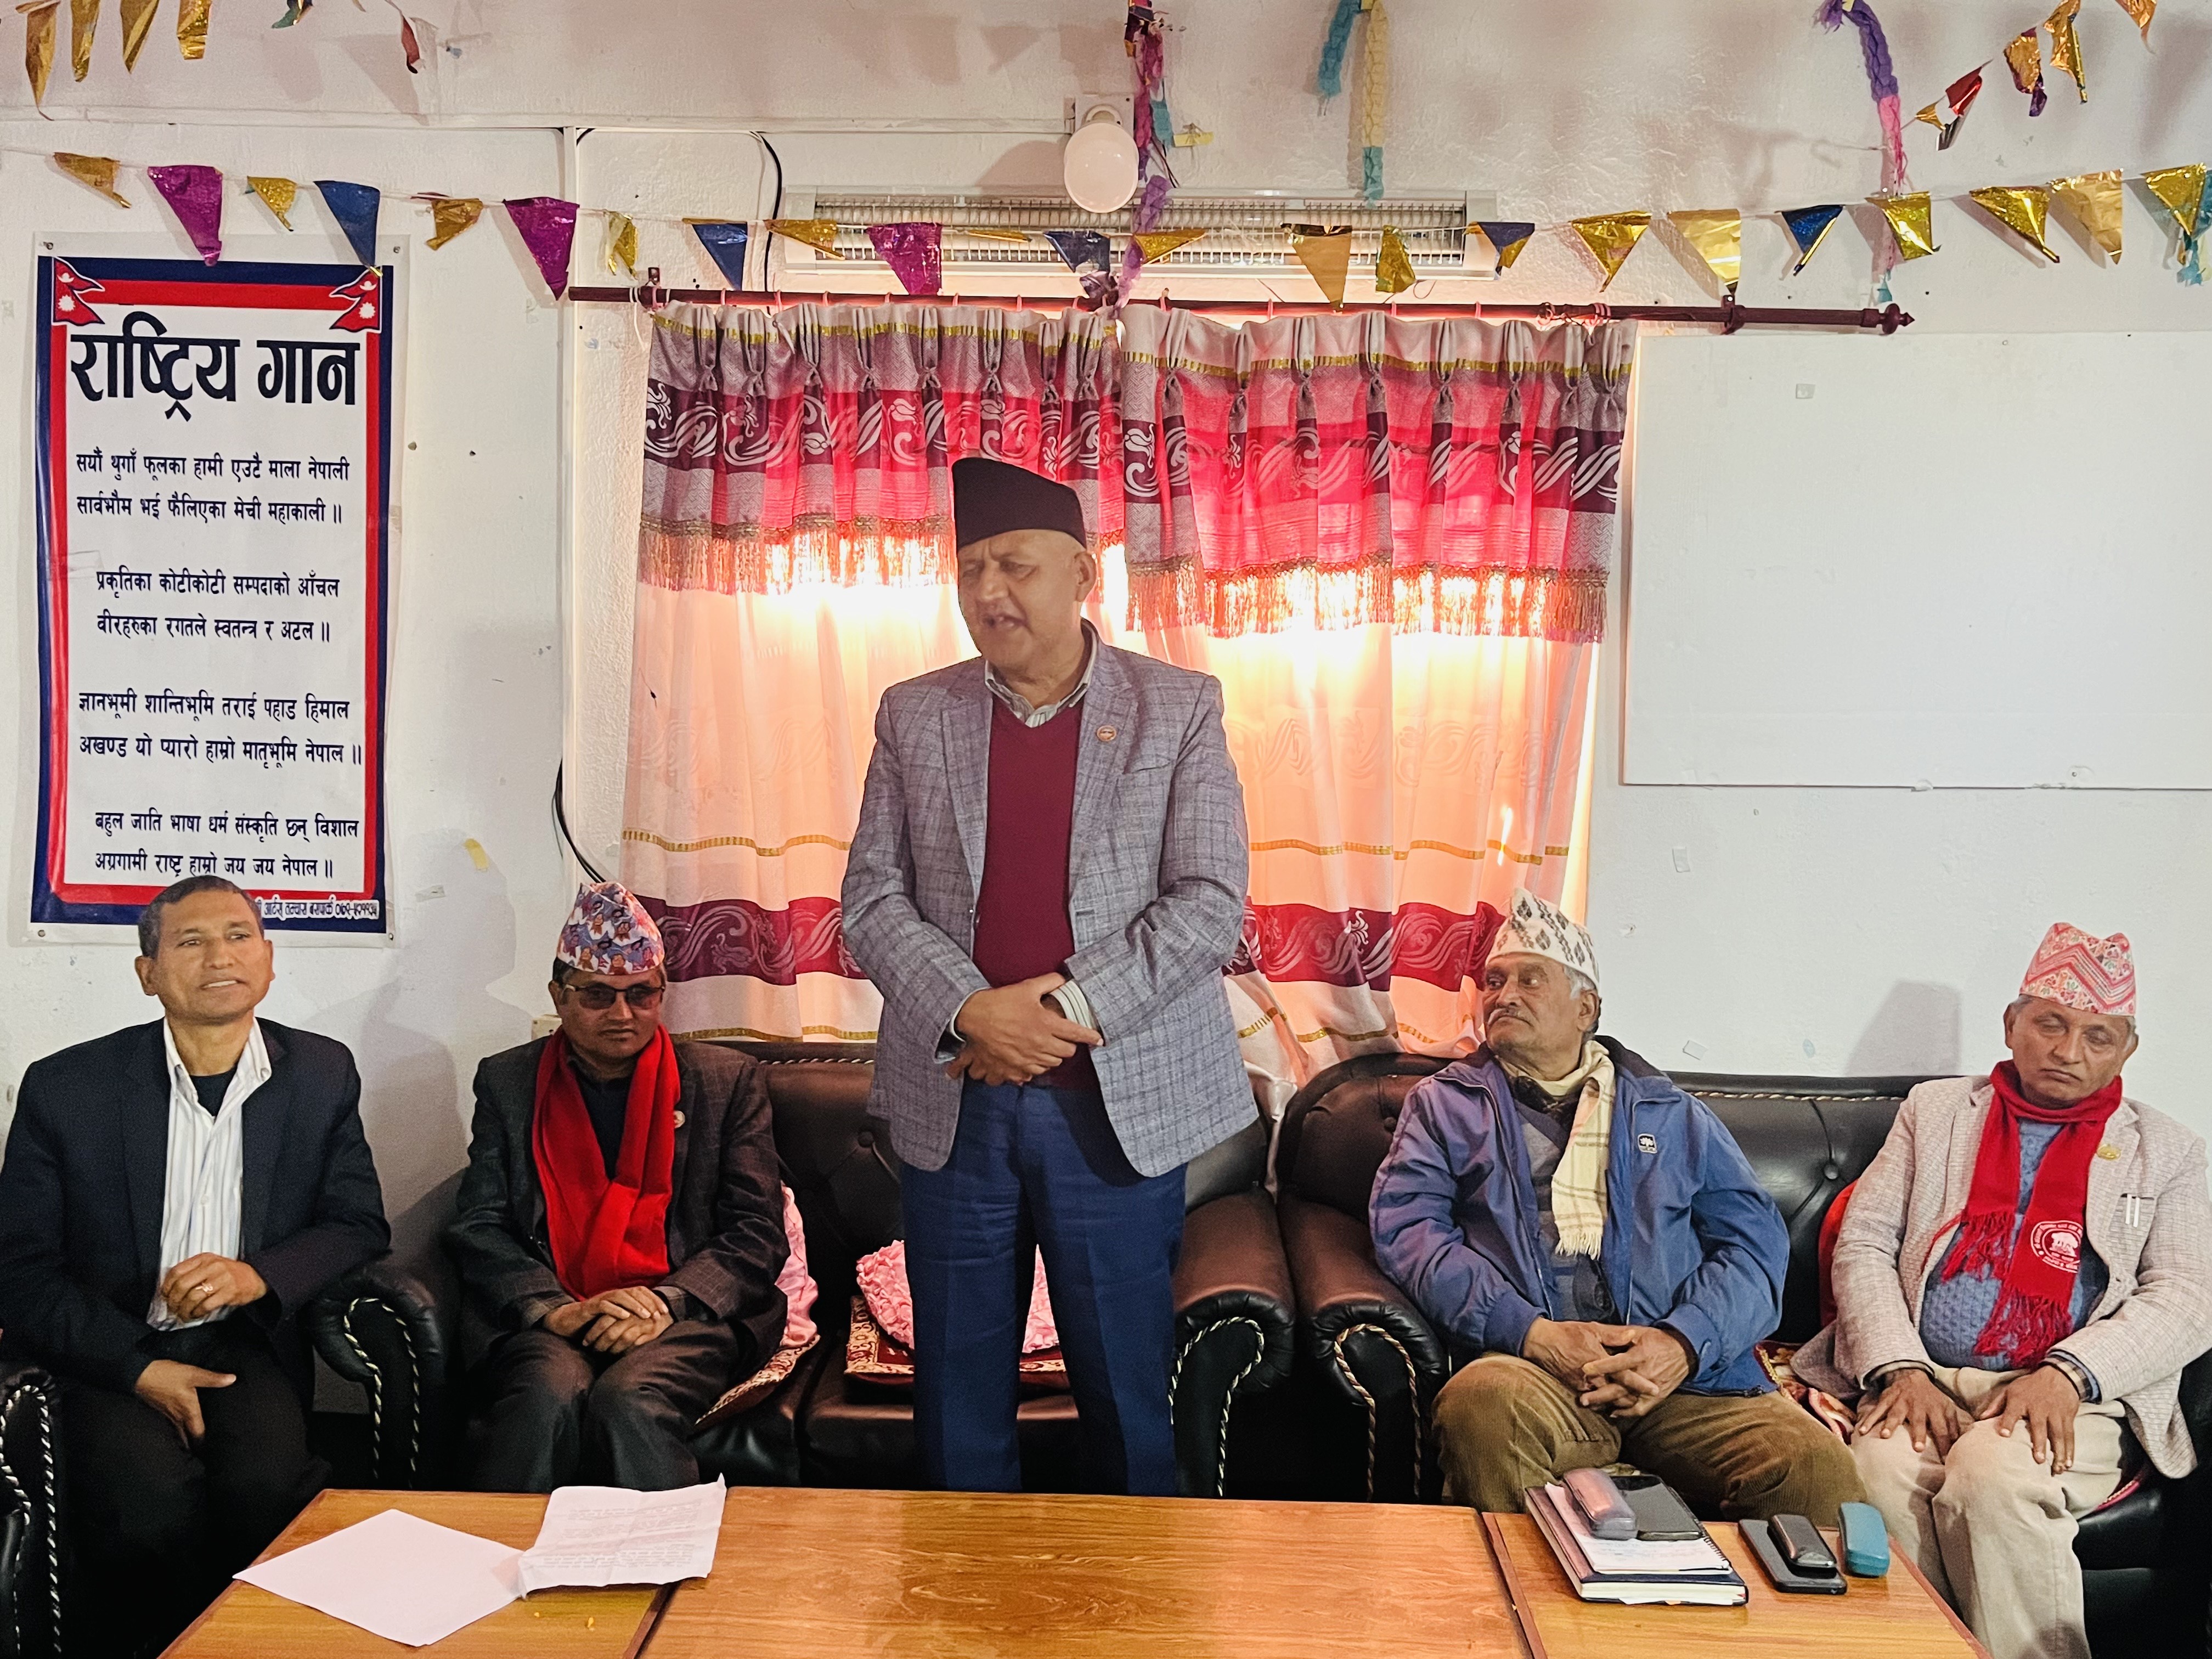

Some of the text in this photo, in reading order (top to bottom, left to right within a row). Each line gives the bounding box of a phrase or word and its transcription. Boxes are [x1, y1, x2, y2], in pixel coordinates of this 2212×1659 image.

[70, 311, 361, 422] राष्ट्रिय गान
[143, 456, 187, 481] फूलका
[194, 453, 223, 480] हामी
[231, 452, 262, 482] एउटै
[269, 461, 301, 478] माला
[308, 456, 349, 481] नेपाली
[77, 489, 132, 515] सार्वभौम
[140, 493, 160, 520] भई
[168, 491, 226, 523] फैलिएका
[234, 496, 261, 520] मेची
[268, 497, 326, 524] महाकाली
[97, 565, 340, 598] प्रकृतिका कोटीकोटी सम्पदाको आँचल
[165, 613, 206, 637] रगतले
[215, 619, 257, 639] स्वतन्त्र
[264, 620, 274, 640] र
[281, 621, 314, 640] अटल
[145, 689, 215, 721] शान्तिभूमि
[222, 692, 257, 720] तराई
[264, 699, 297, 721] पहाड
[305, 693, 349, 723] हिमाल
[80, 736, 128, 757] अखण्ड
[136, 733, 152, 756] यो
[161, 734, 198, 759] प्यारो
[206, 736, 235, 763] हाम्रो
[242, 736, 297, 769] मातृभूमि
[306, 738, 344, 763] नेपाल
[95, 812, 124, 837] बहुल
[131, 807, 162, 831] जाति
[171, 815, 201, 832] भाषा
[209, 810, 228, 833] धर्म
[235, 811, 278, 842] संस्कृति
[315, 812, 359, 837] विशाल
[95, 848, 148, 870] अग्रगामी
[189, 851, 217, 877] हाम्रो
[224, 857, 245, 875] जय
[253, 859, 275, 875] जय
[282, 854, 318, 876] नेपाल
